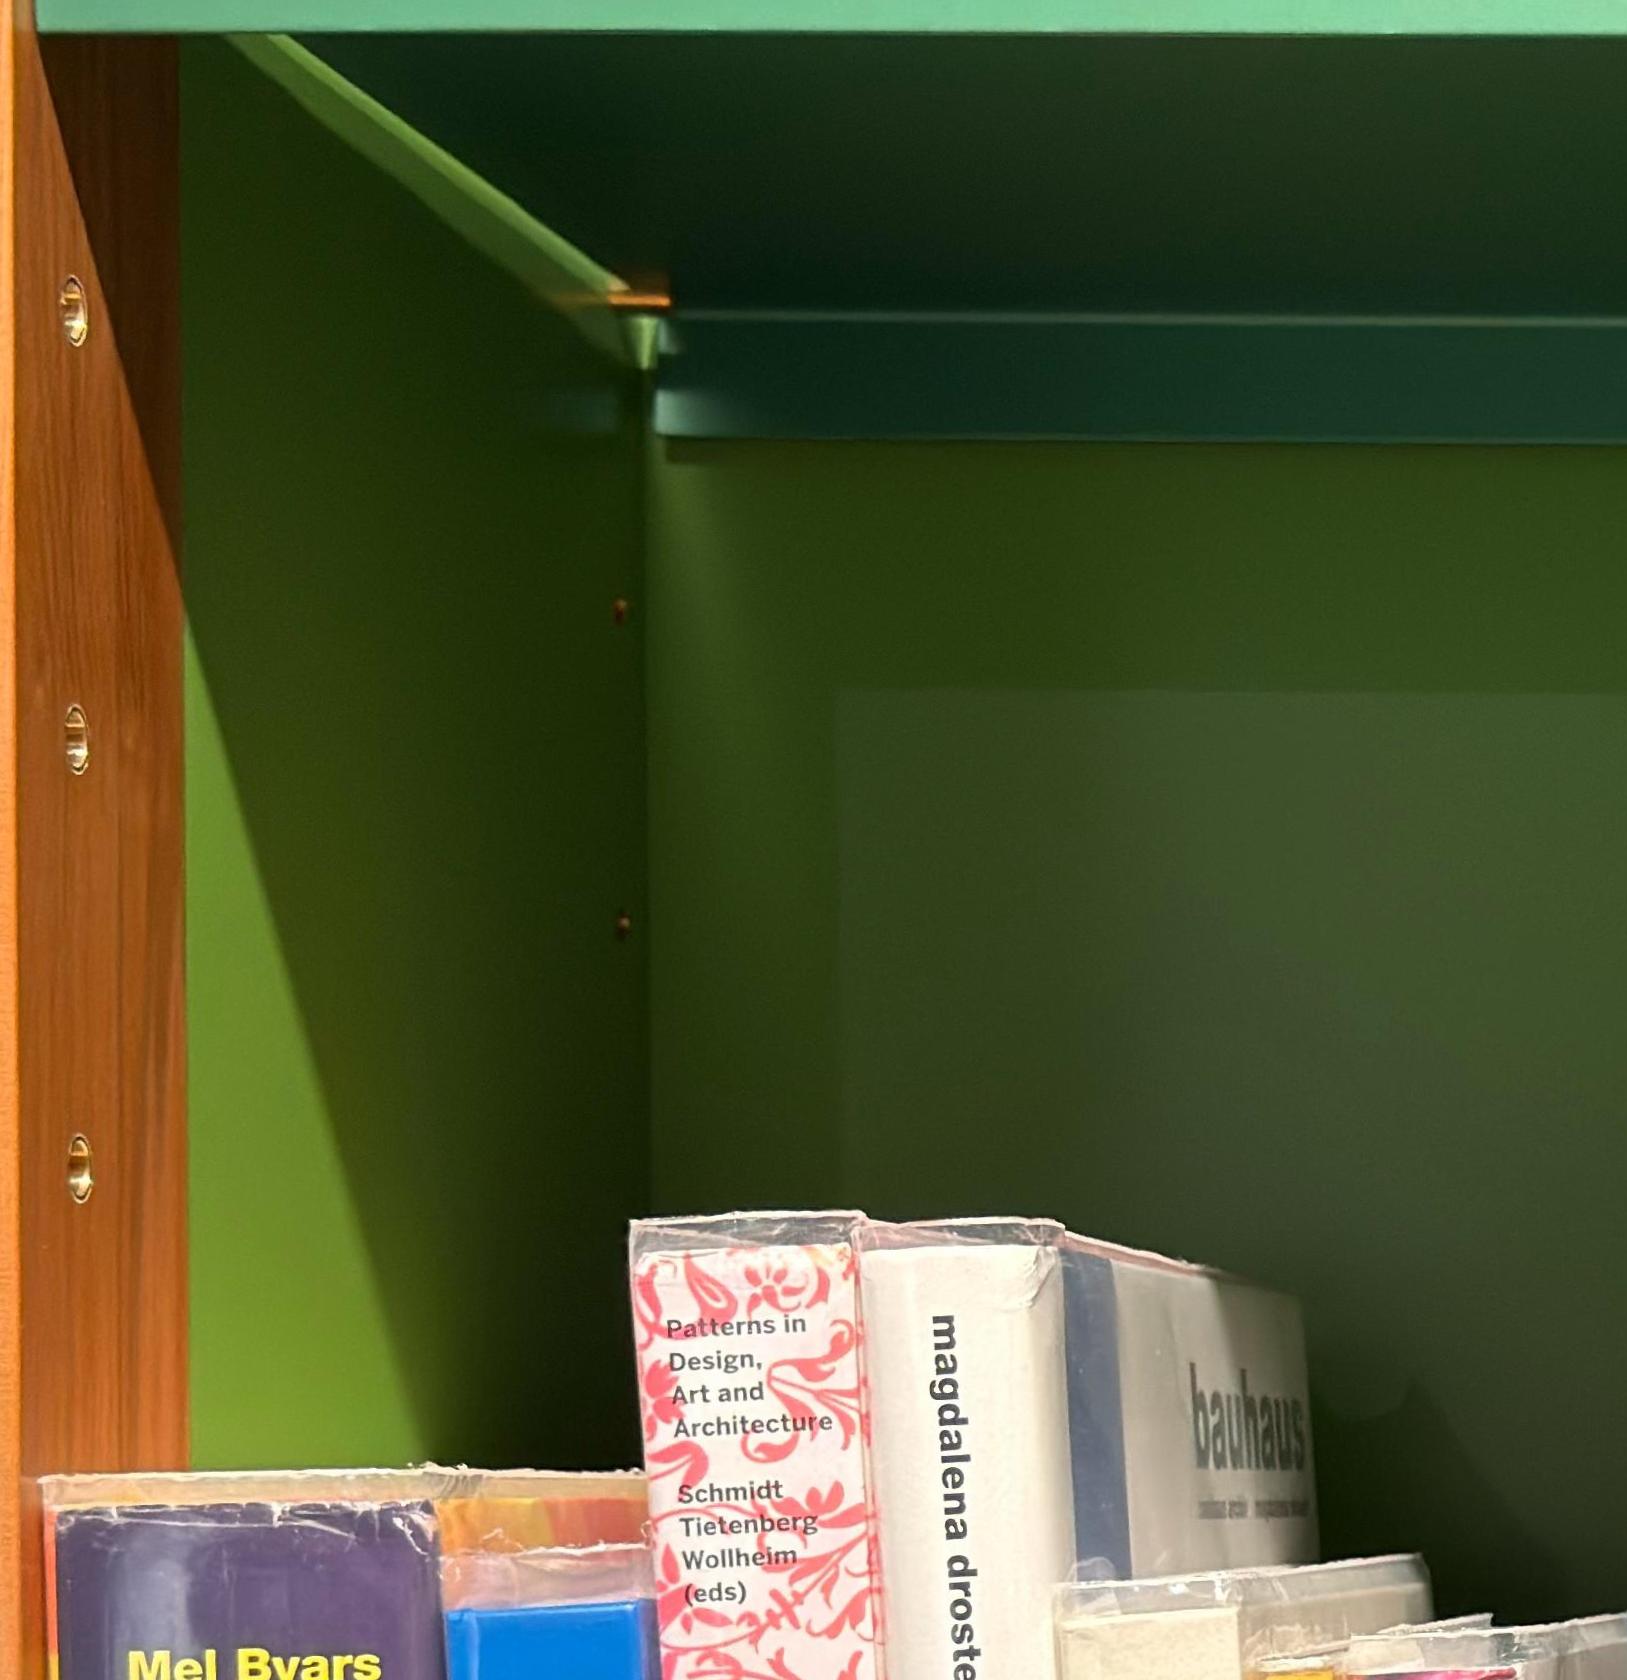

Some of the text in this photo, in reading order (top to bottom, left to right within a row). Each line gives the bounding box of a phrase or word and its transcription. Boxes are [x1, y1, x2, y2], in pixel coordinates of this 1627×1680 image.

[666, 1314, 808, 1340] Patterns in
[668, 1350, 764, 1376] Design,
[671, 1381, 765, 1405] Art and
[673, 1412, 833, 1439] Architecture
[929, 1314, 970, 1542] magdalena
[1189, 1361, 1307, 1470] bauhaus
[677, 1479, 784, 1504] Schmidt
[679, 1512, 819, 1539] Tietenberg
[682, 1545, 798, 1570] Wollheim
[684, 1580, 747, 1607] (eds)
